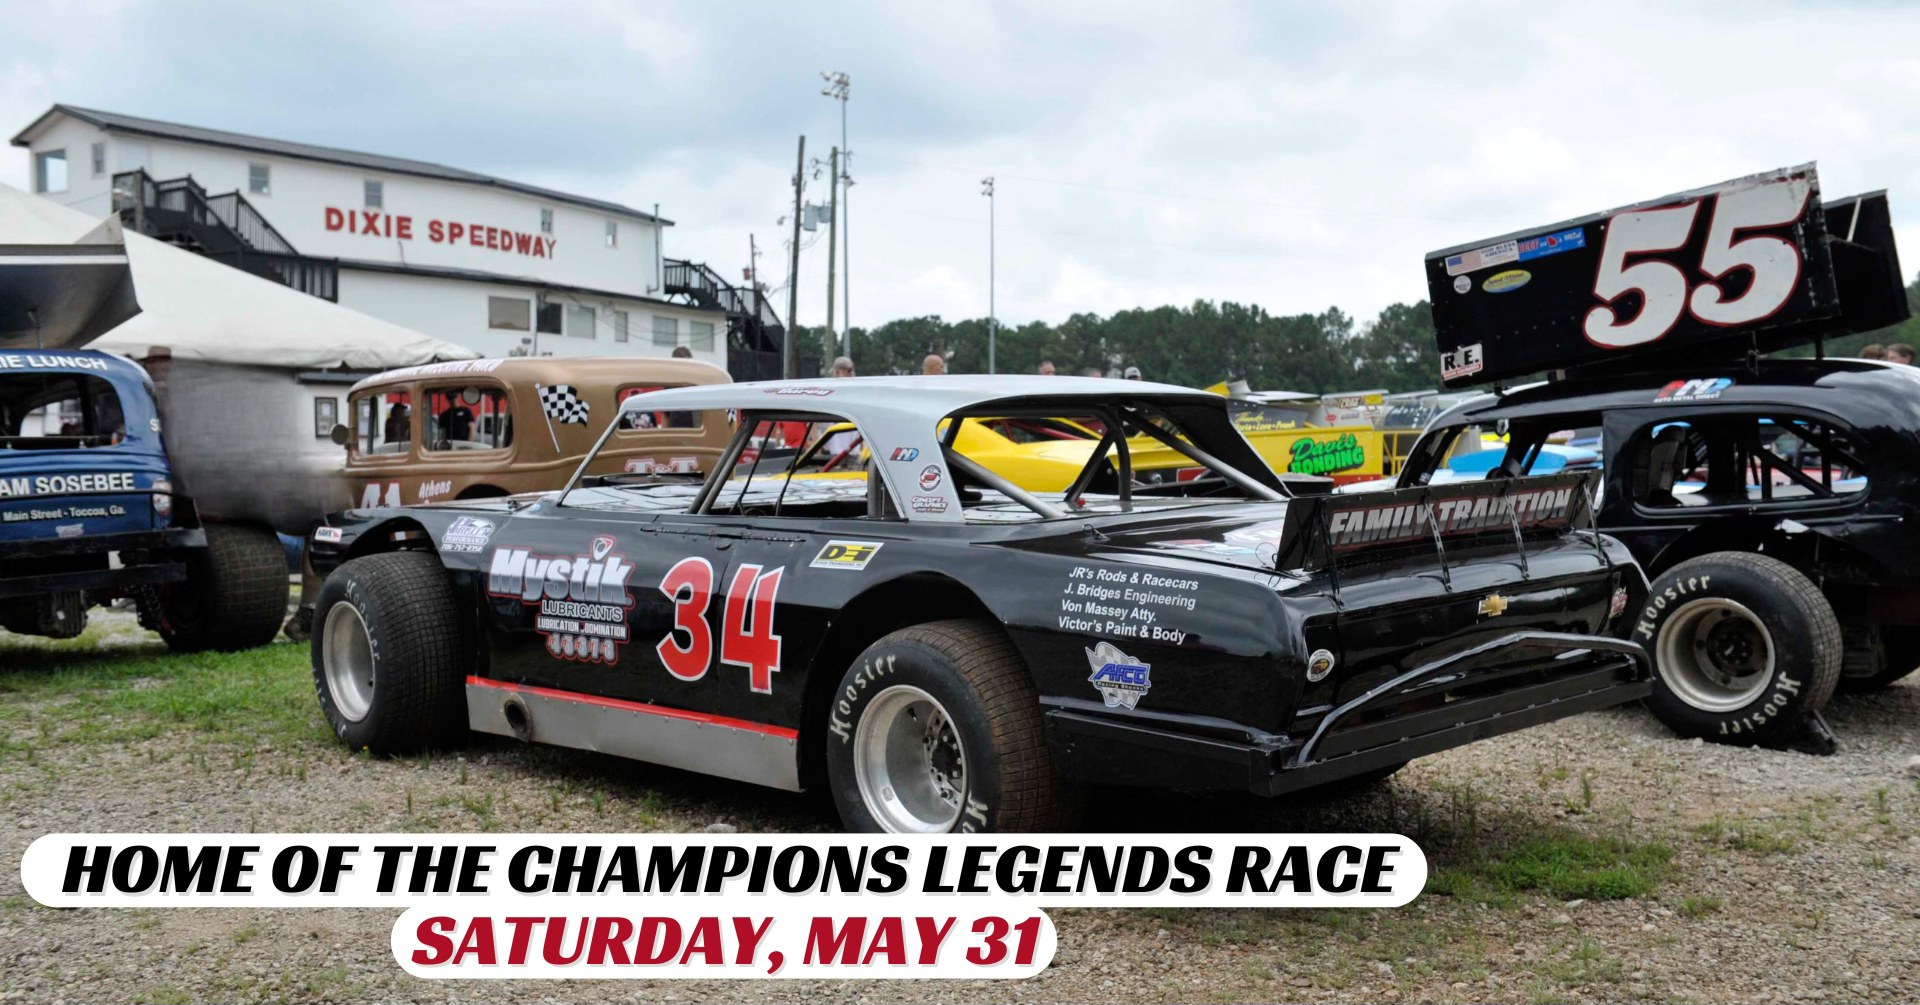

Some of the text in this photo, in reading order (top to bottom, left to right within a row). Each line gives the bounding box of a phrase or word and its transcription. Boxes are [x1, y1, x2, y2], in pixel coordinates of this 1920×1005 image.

[325, 207, 556, 260] DIXIE SPEEDWAY
[1582, 176, 1813, 349] 55
[0, 354, 108, 370] IE LUNCH
[35, 472, 136, 494] SOSEBEE
[418, 480, 452, 500] Athens
[3, 511, 29, 522] Main
[30, 509, 62, 520] Street
[69, 506, 108, 518] Toccoa,
[109, 504, 126, 515] Ga.
[1329, 503, 1434, 546] FAMILY
[488, 536, 634, 608] Mystik
[1069, 566, 1199, 591] JR's Rods & Racecars
[541, 600, 623, 622] LUBRICANTS
[1061, 599, 1157, 623] Von Massey Atty.
[1064, 583, 1197, 611] J. Bridges Engineering
[1637, 575, 1711, 640] Hoosier
[537, 617, 627, 639] LUBRICATION DOMINATION
[656, 556, 785, 695] 34
[1058, 616, 1186, 645] Victor's Paint & Body
[1093, 663, 1148, 685] AFCO
[830, 654, 896, 744] Hoosier
[1719, 671, 1802, 735] Hoosier
